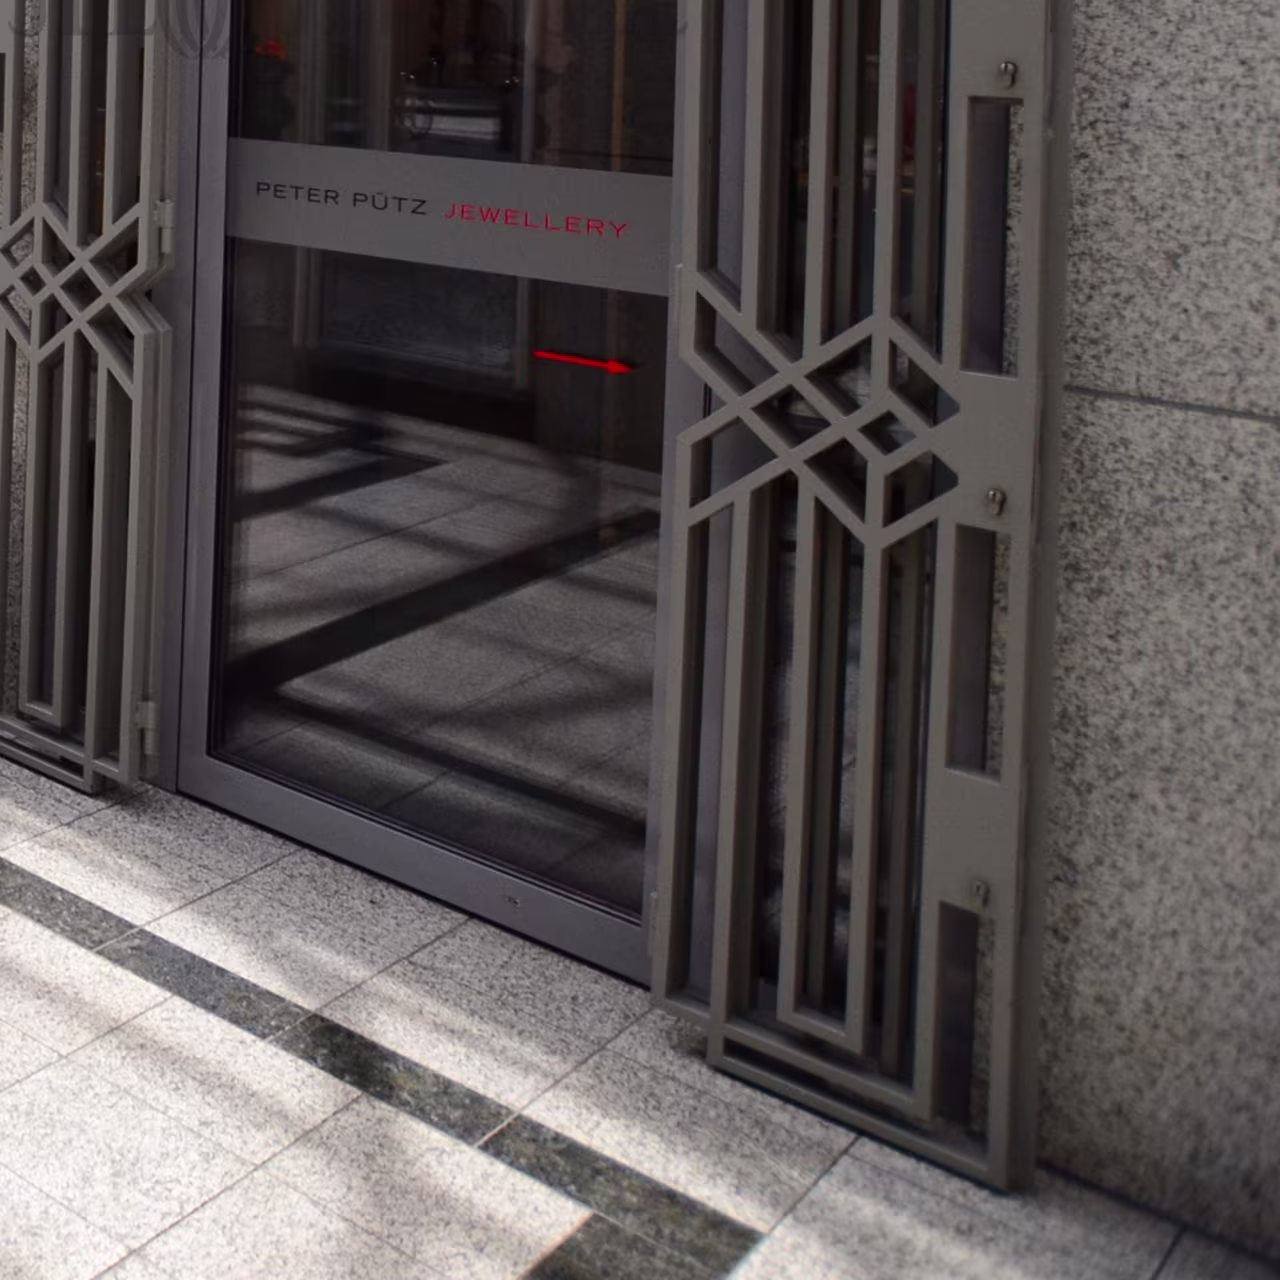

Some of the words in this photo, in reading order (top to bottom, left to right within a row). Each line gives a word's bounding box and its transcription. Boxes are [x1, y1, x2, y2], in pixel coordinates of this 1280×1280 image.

[255, 180, 340, 205] PETER
[352, 191, 428, 216] PÜTZ
[444, 202, 629, 239] JEWELLERY
